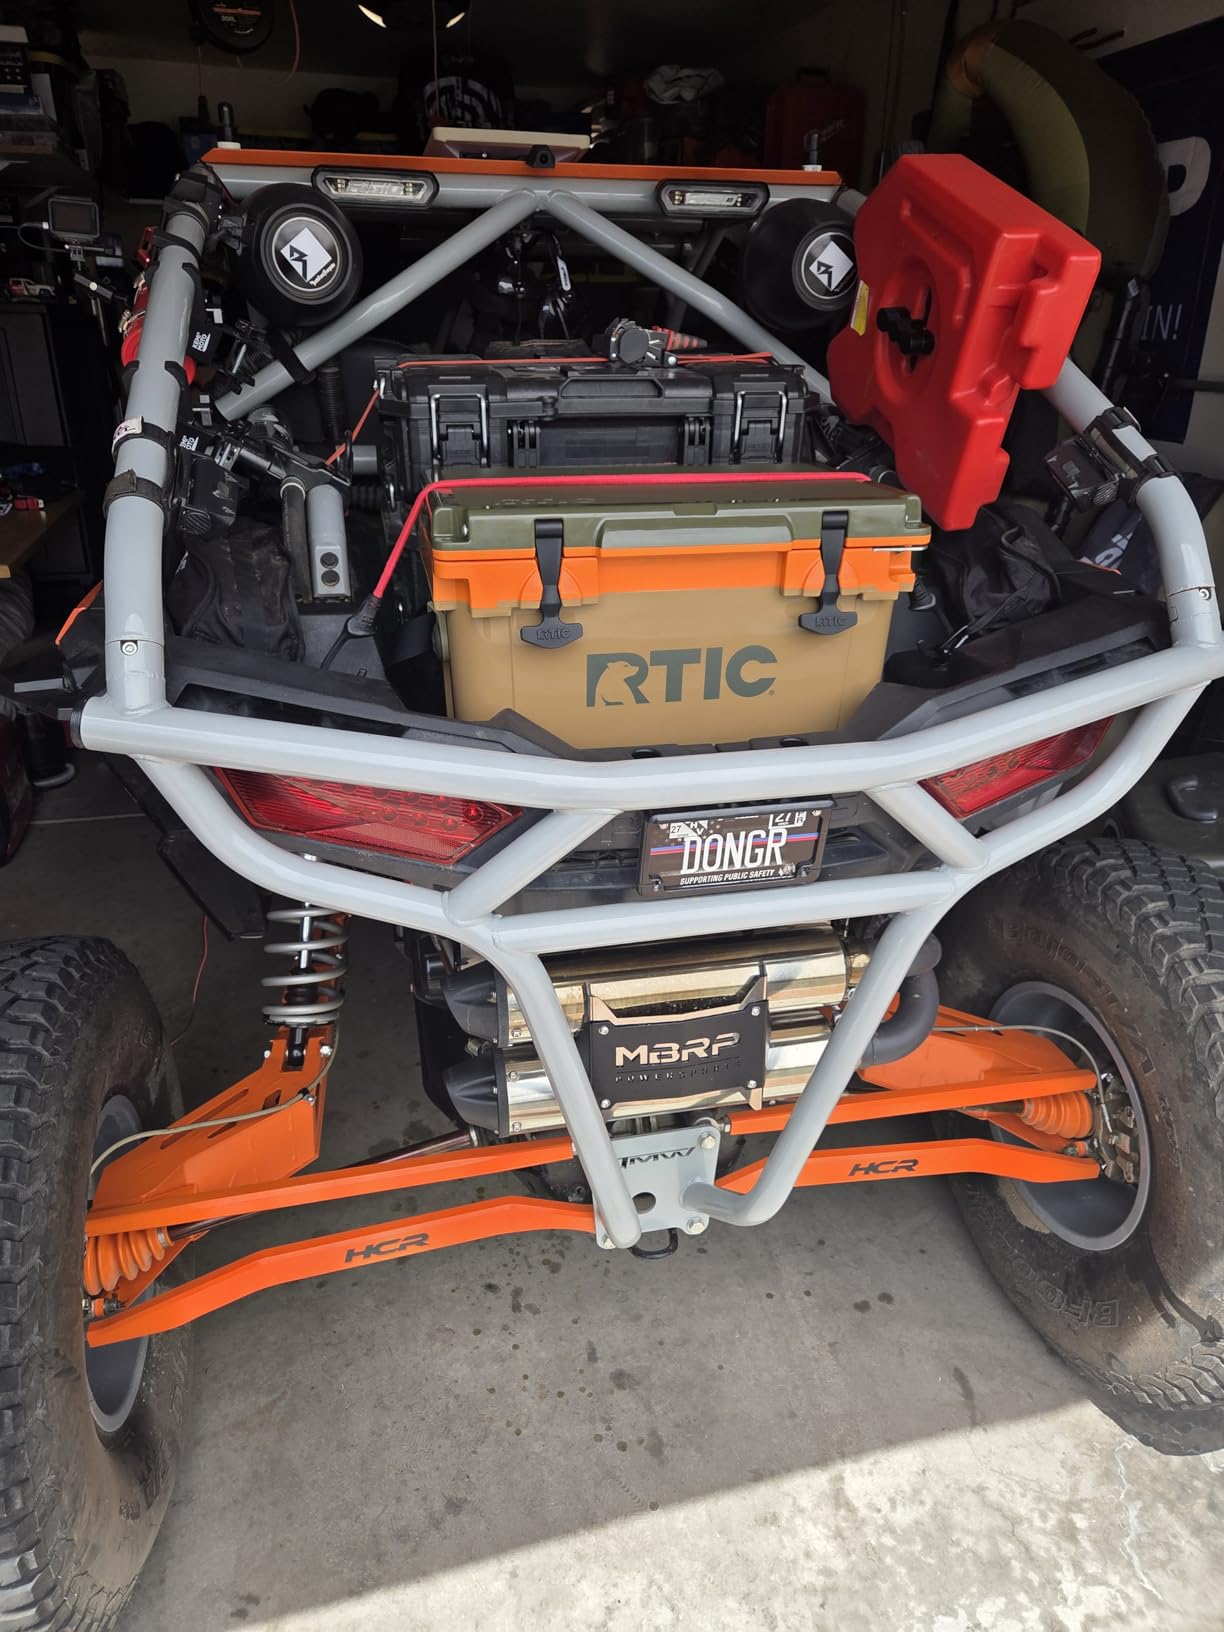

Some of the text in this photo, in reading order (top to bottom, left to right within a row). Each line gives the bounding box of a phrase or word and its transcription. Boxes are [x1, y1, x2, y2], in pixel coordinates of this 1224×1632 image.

[815, 614, 848, 628] RTIC
[536, 627, 570, 641] RTIC
[586, 645, 777, 707] RTIC
[671, 825, 682, 834] 27
[680, 828, 788, 874] DONGR
[680, 868, 775, 886] SUPPORTING PUBLIC SAFETY
[615, 1032, 741, 1067] MBRP
[847, 1158, 919, 1176] HCR
[344, 1232, 430, 1263] HCR
